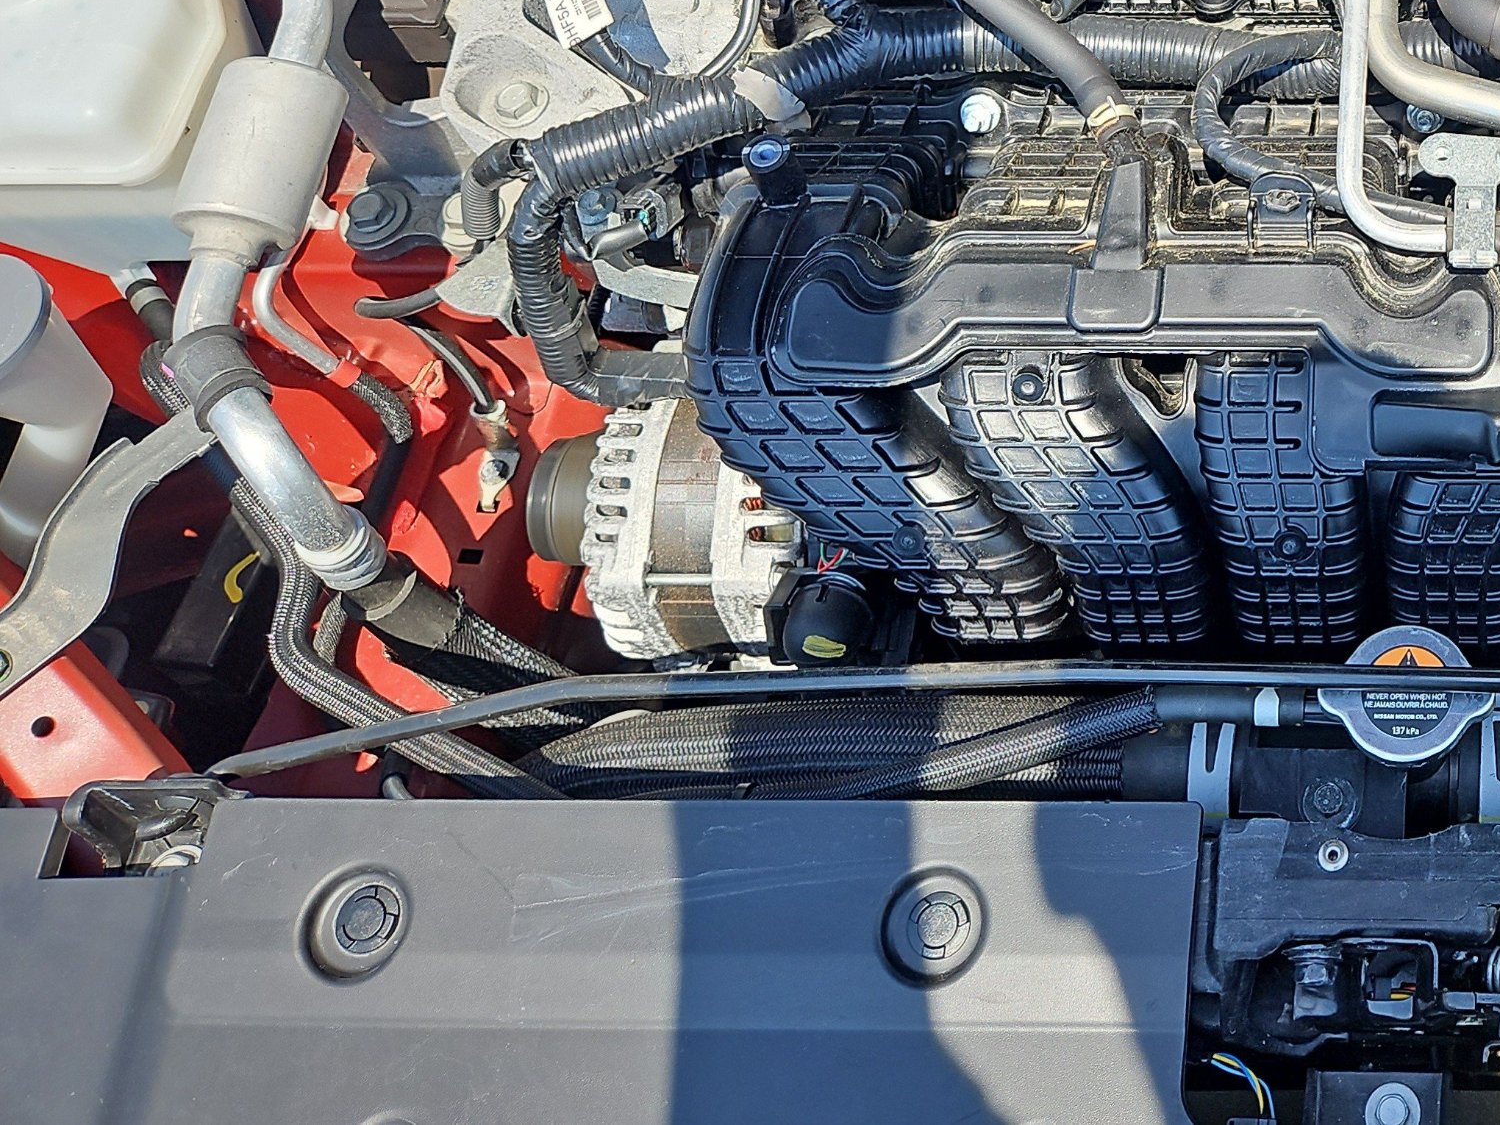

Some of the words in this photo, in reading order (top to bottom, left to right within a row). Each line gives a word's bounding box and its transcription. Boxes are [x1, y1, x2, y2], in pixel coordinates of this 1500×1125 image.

[1409, 693, 1431, 701] WHEN
[1431, 693, 1448, 701] HOT.
[1364, 700, 1373, 708] NE
[1392, 726, 1405, 735] 137
[1406, 727, 1420, 735] kPa
